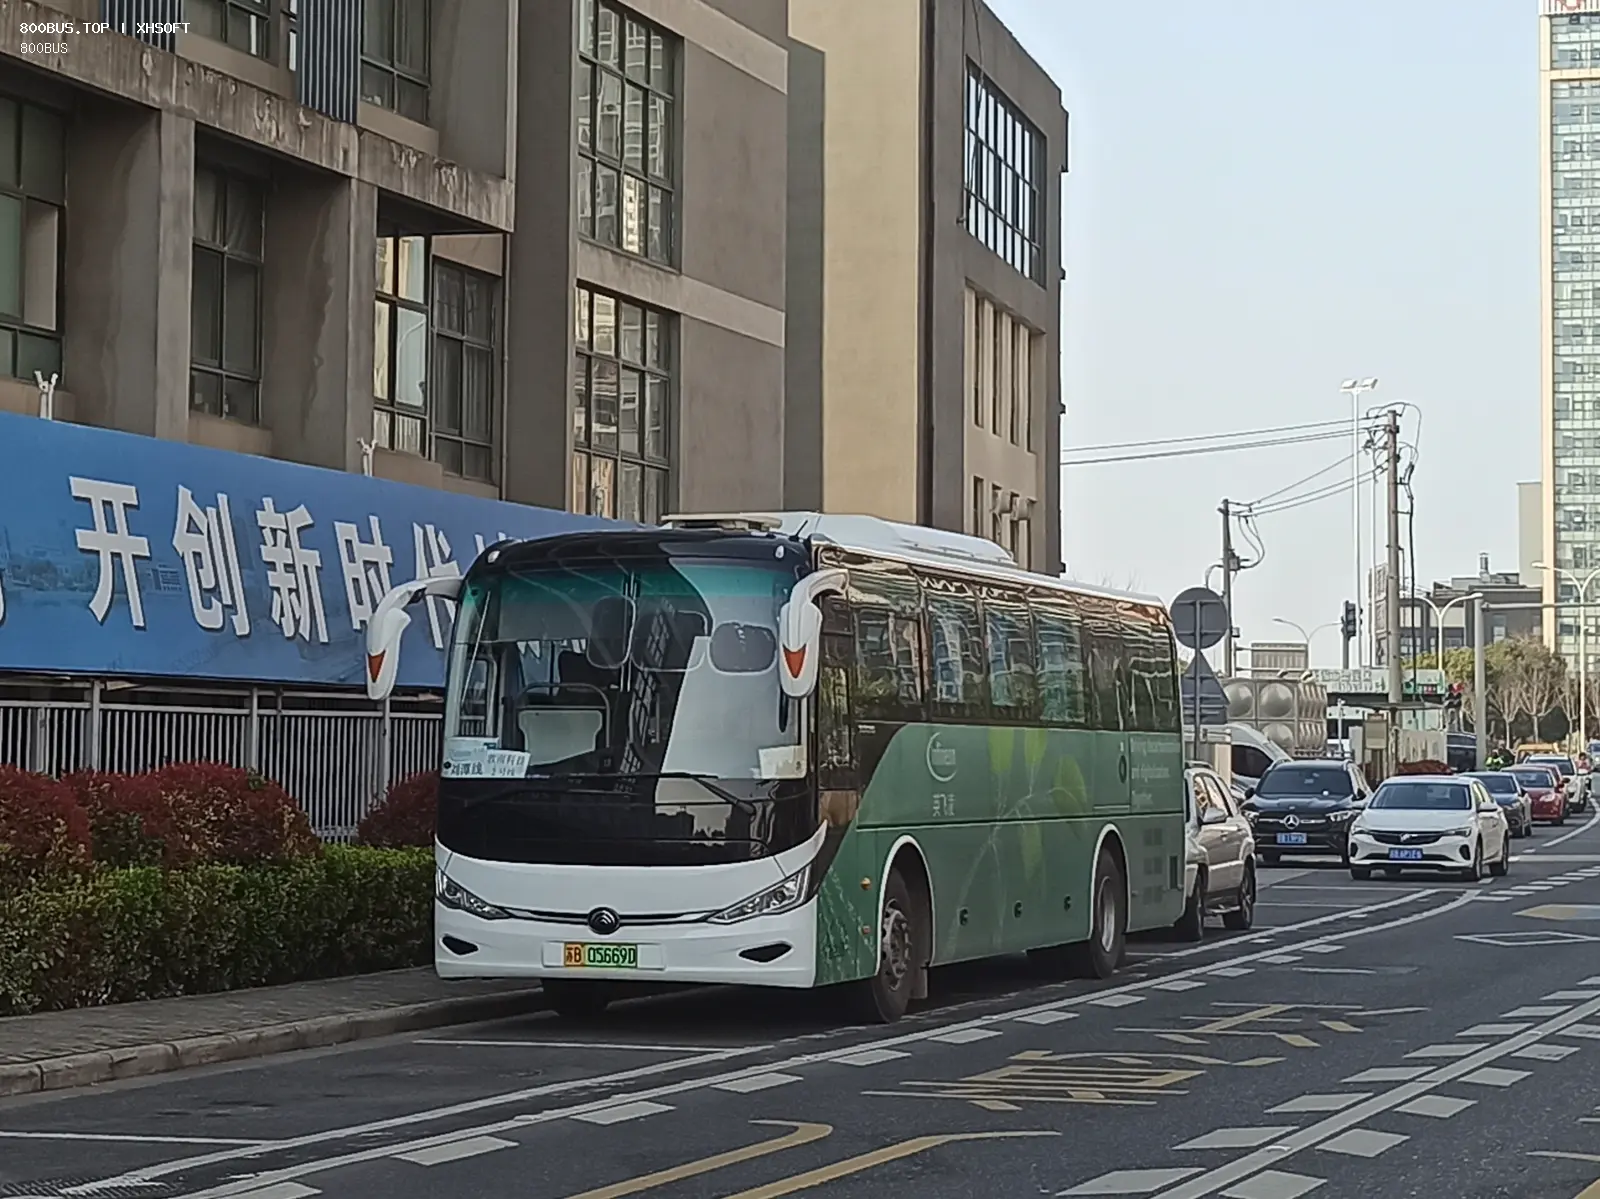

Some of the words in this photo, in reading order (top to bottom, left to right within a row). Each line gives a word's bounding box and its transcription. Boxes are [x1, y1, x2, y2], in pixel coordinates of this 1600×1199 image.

[69, 475, 506, 648] 开创新时代
